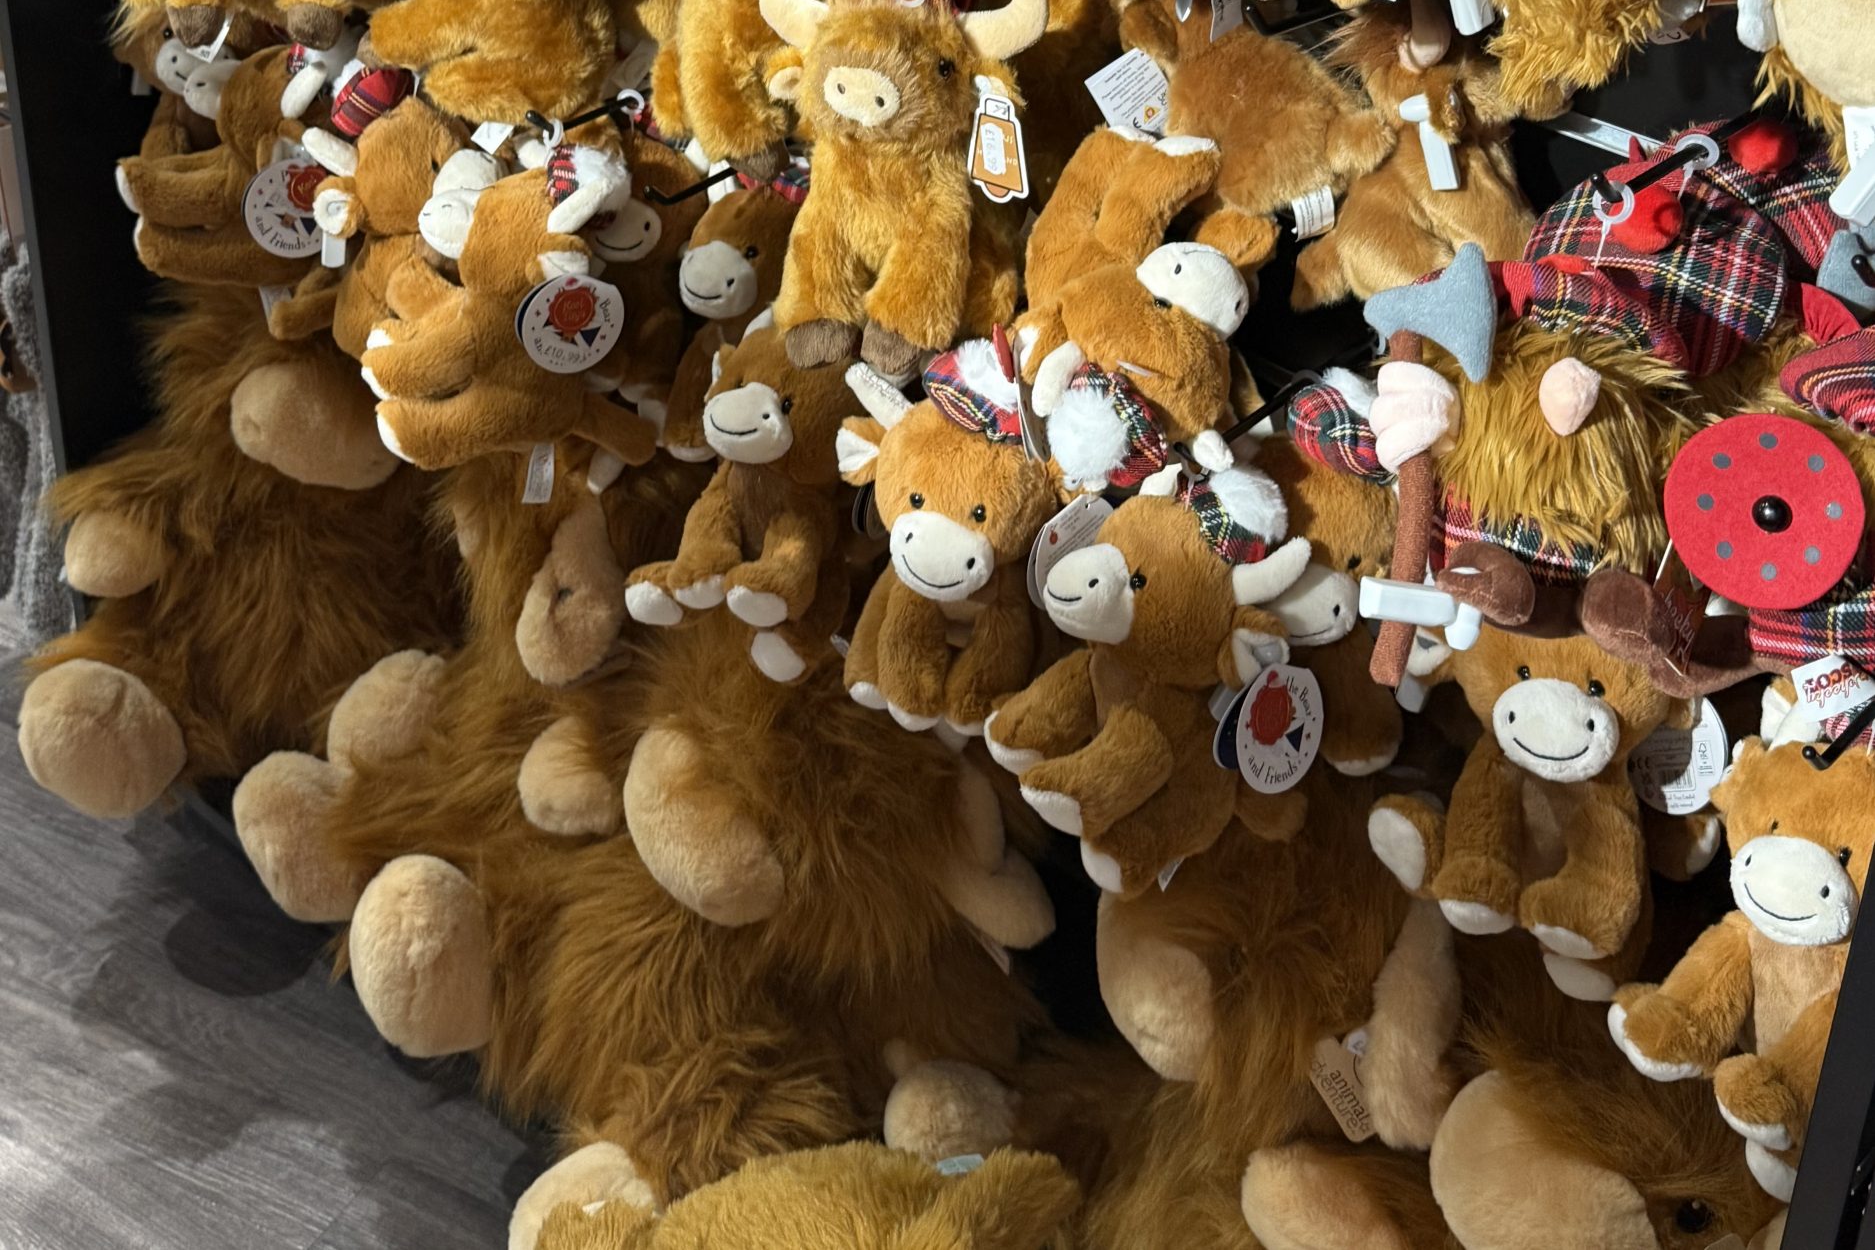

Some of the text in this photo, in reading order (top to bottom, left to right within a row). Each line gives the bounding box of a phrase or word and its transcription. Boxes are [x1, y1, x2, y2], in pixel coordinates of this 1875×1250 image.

[270, 232, 306, 250] Friends
[599, 298, 612, 323] Bear
[1299, 686, 1312, 717] Bear
[1248, 755, 1298, 785] and Friends
[1311, 1060, 1359, 1129] dventure
[1329, 1069, 1371, 1123] animal
